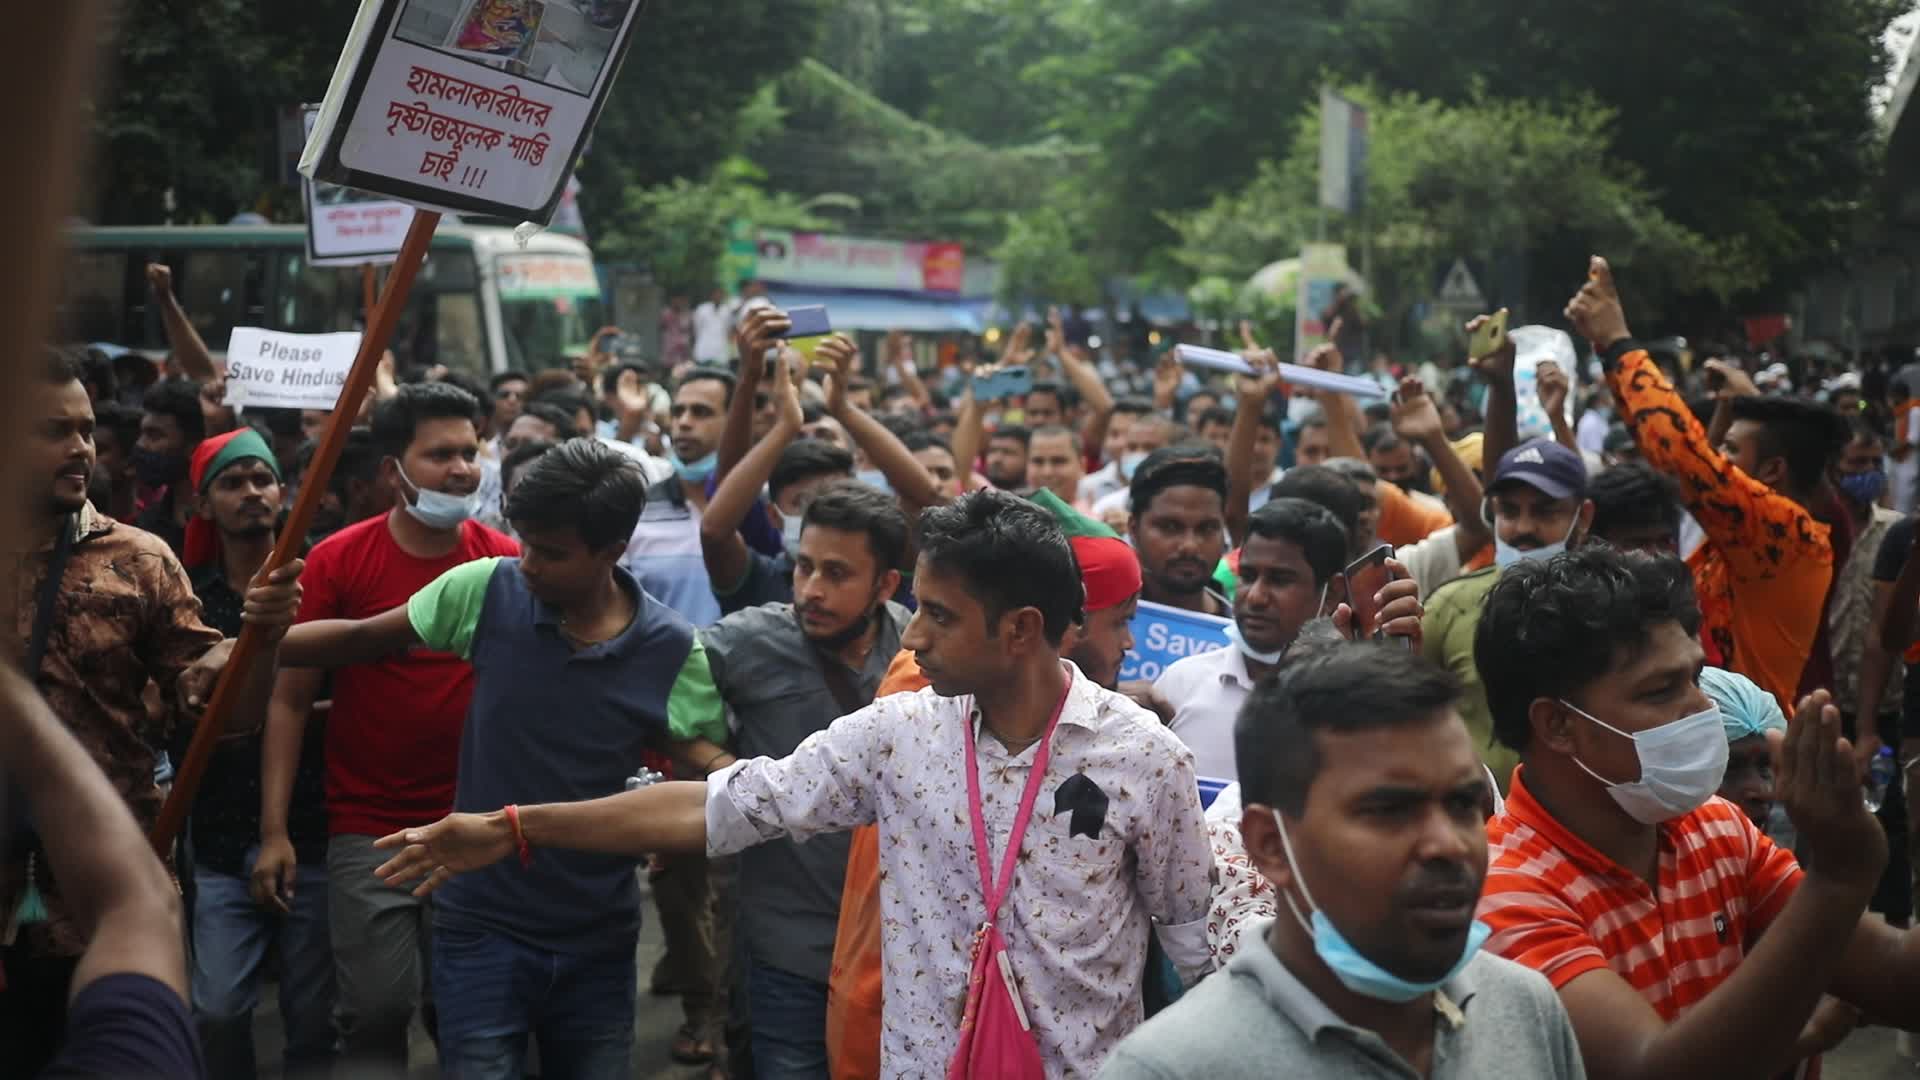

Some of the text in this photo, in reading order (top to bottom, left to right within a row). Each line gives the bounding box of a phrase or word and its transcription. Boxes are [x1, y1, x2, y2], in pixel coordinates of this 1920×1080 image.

[406, 65, 552, 127] হামলাকারীদের
[386, 101, 551, 166] দৃষ্টান্তমূলক শাস্তি
[419, 150, 459, 183] চাই
[258, 340, 323, 361] Please
[230, 361, 346, 386] Save Hindus
